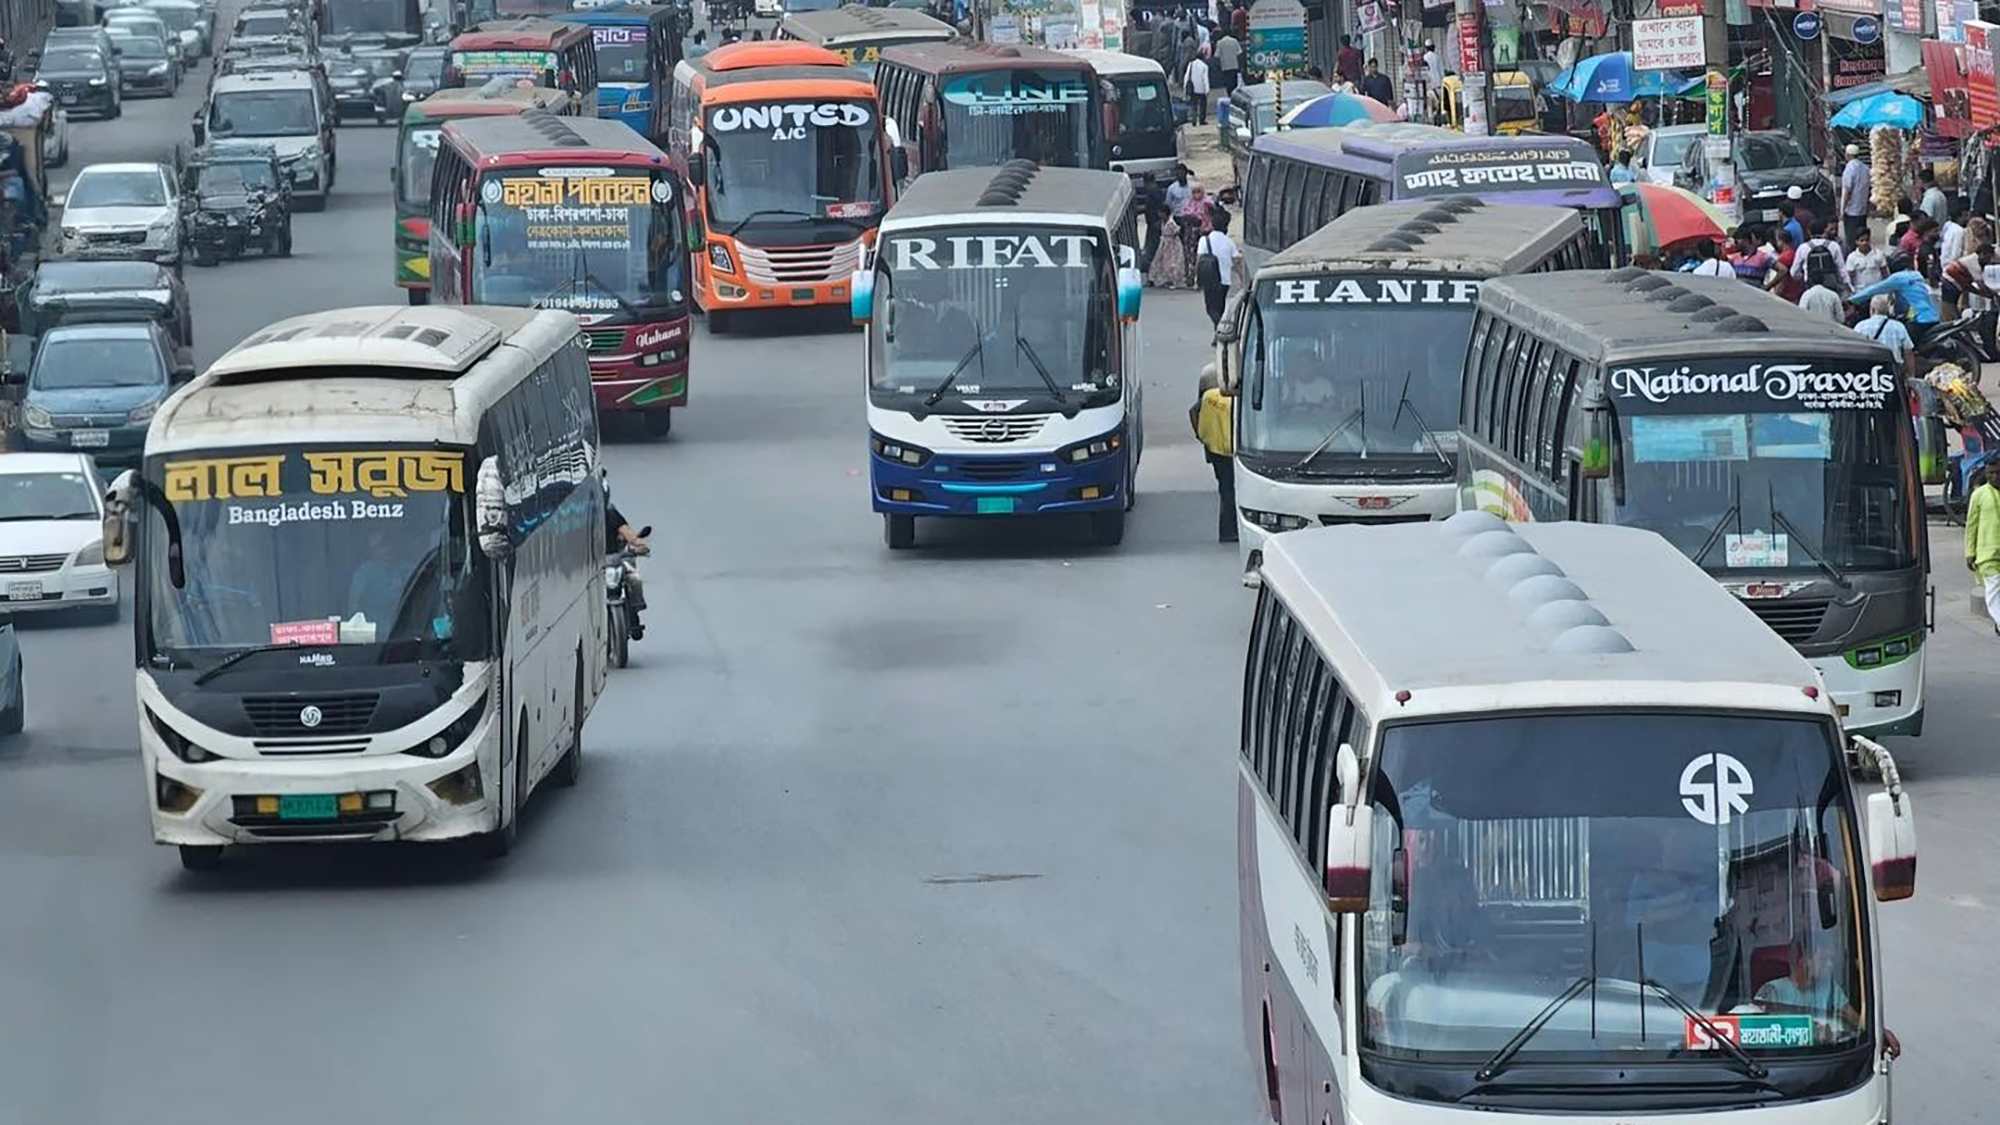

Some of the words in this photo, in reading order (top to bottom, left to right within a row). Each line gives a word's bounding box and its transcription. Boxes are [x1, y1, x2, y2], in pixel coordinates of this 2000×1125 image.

[1639, 21, 1671, 33] এখানে
[1676, 20, 1694, 31] বাস
[1668, 38, 1675, 48] ও
[713, 104, 870, 131] UNITED
[771, 127, 807, 140] A/C
[1537, 160, 1600, 182] আলী
[567, 177, 651, 206] পরিবহন
[890, 235, 1098, 271] RIFAT
[636, 326, 682, 348] Nuhana
[1611, 364, 1762, 402] National
[1764, 364, 1895, 400] Travels
[164, 455, 285, 500] লাল
[303, 450, 465, 498] সবুজ
[228, 501, 346, 525] Bangladesh
[351, 500, 404, 519] Benz
[1680, 752, 1753, 825] SR
